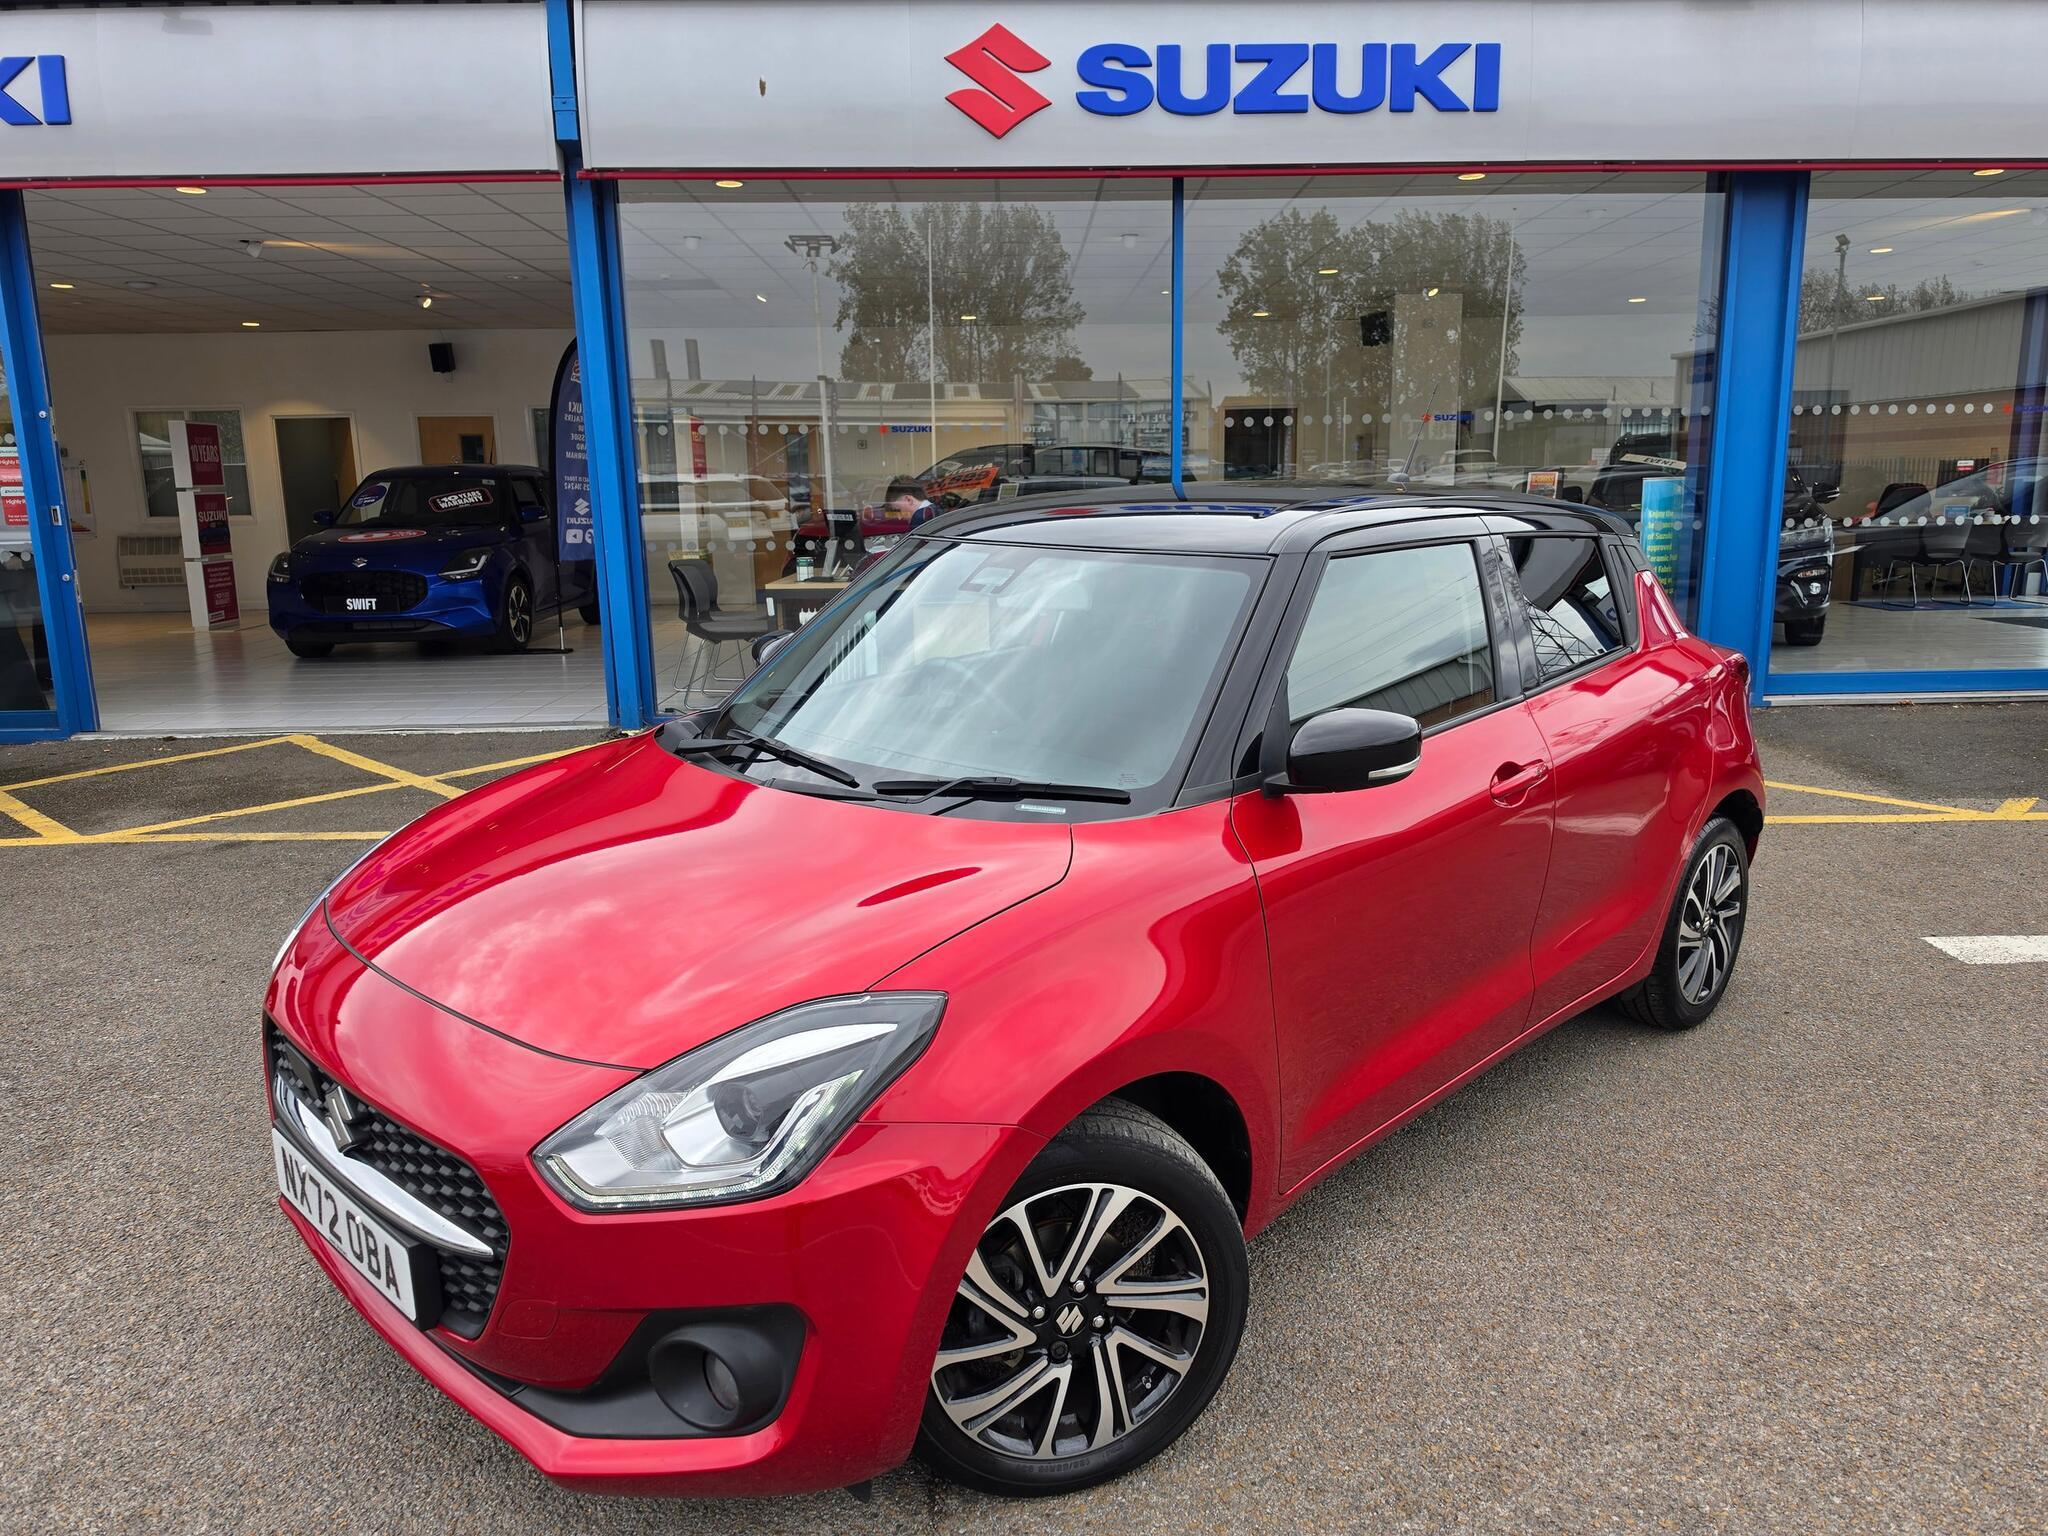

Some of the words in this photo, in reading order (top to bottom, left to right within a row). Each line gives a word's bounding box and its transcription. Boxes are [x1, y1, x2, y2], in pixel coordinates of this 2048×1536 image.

[1075, 42, 1501, 116] SUZUKI
[891, 425, 932, 433] SUZUKI
[190, 445, 199, 462] 10
[199, 445, 220, 463] YEARS
[1643, 457, 1676, 466] EVENT
[458, 490, 482, 500] YEARS
[439, 496, 484, 509] WARRANTY
[198, 510, 227, 522] SUZUKI
[346, 598, 377, 611] SWIFT
[281, 1146, 343, 1245] NX72
[346, 1209, 402, 1300] OBA
